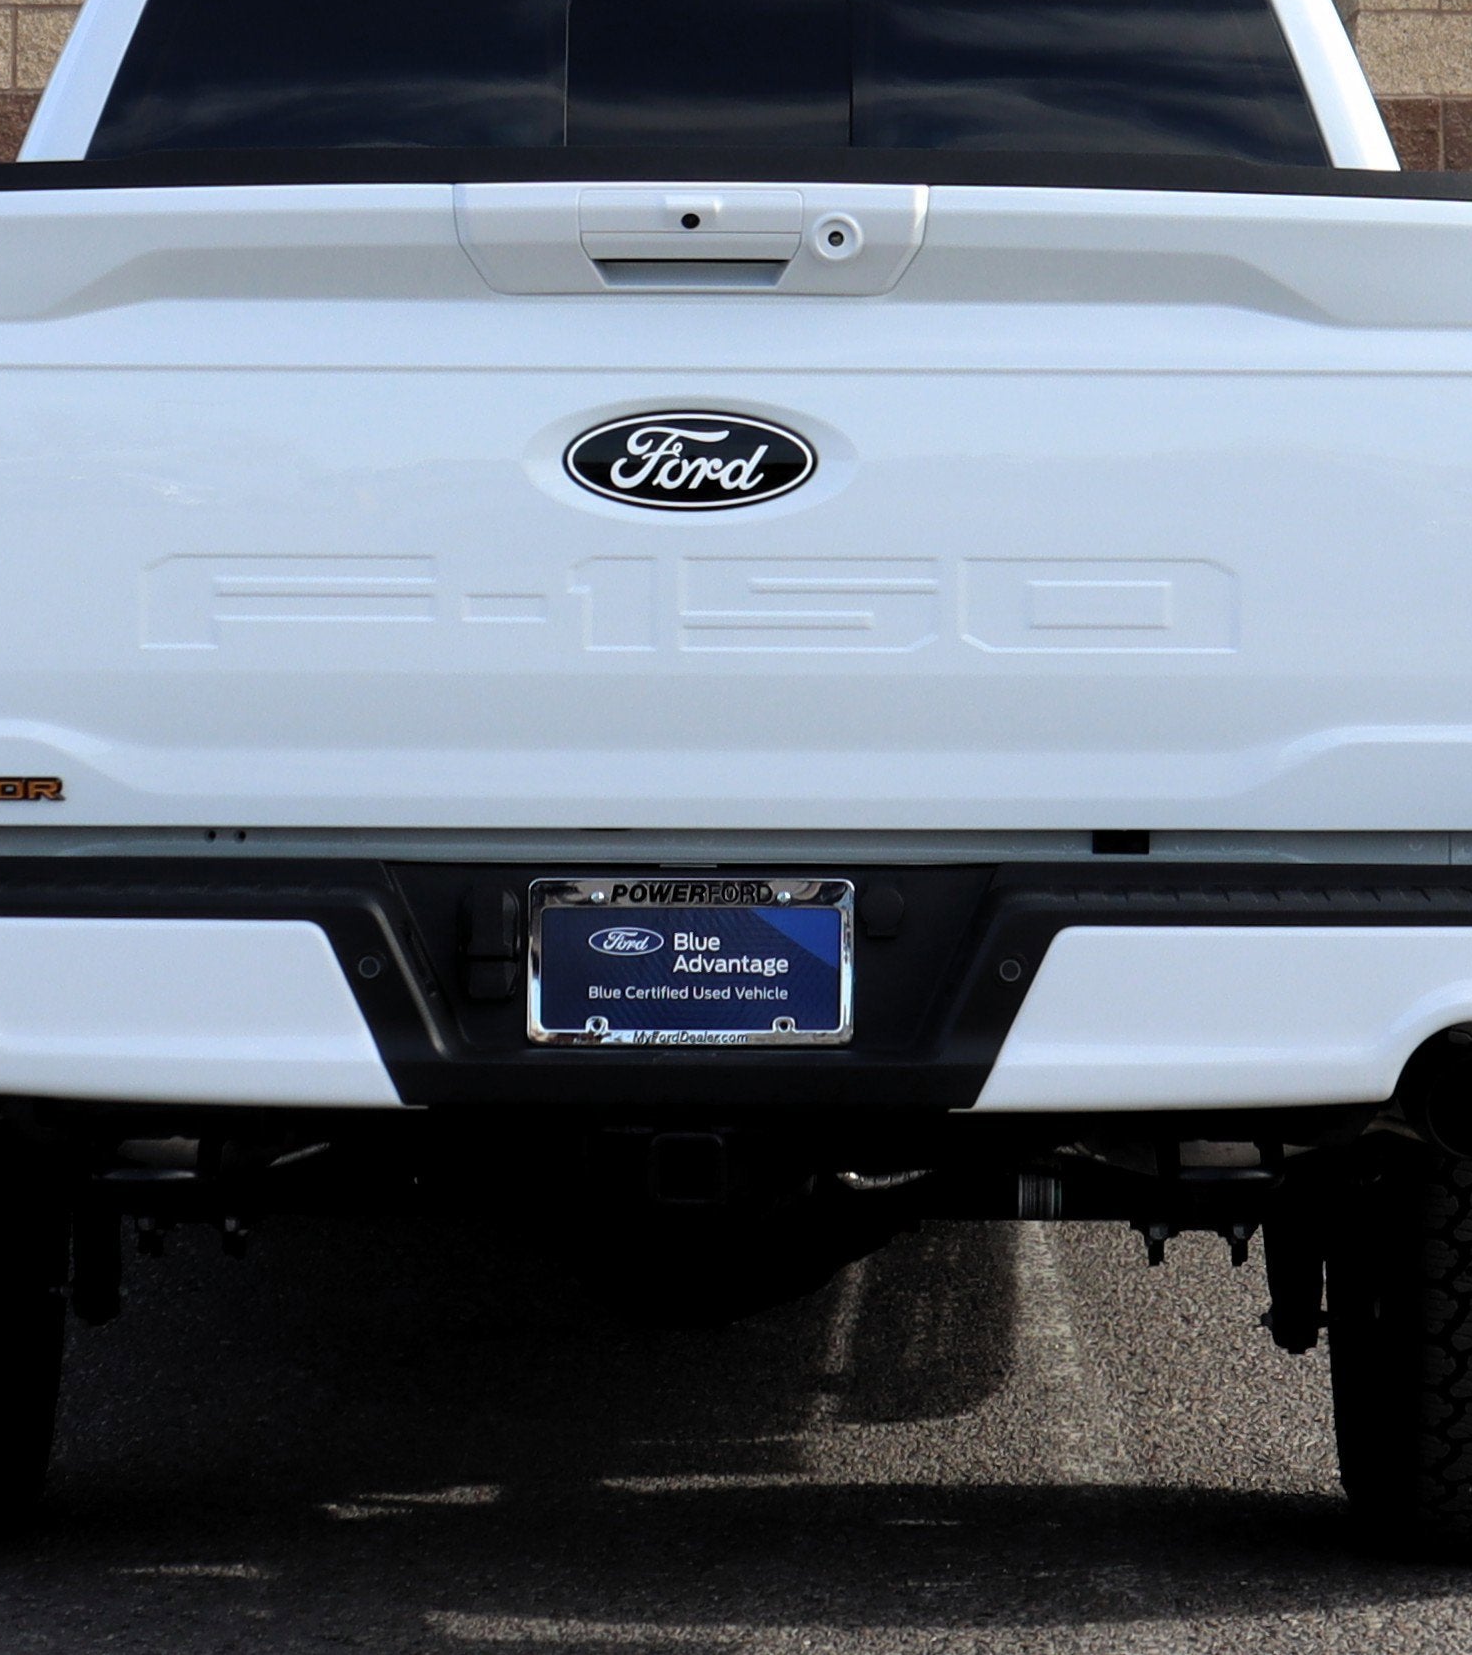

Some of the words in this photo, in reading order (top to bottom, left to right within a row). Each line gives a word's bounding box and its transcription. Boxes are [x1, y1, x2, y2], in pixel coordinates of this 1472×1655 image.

[610, 425, 764, 494] Ford
[139, 554, 1239, 653] F-150
[602, 931, 650, 952] Ford
[673, 932, 721, 952] Blue
[672, 955, 789, 977] Advantage
[588, 986, 622, 1000] Blue
[625, 985, 689, 1000] Certified
[692, 986, 731, 1000] Used
[734, 985, 789, 1000] Vehicle
[632, 1030, 749, 1045] MyFordDealer.com
